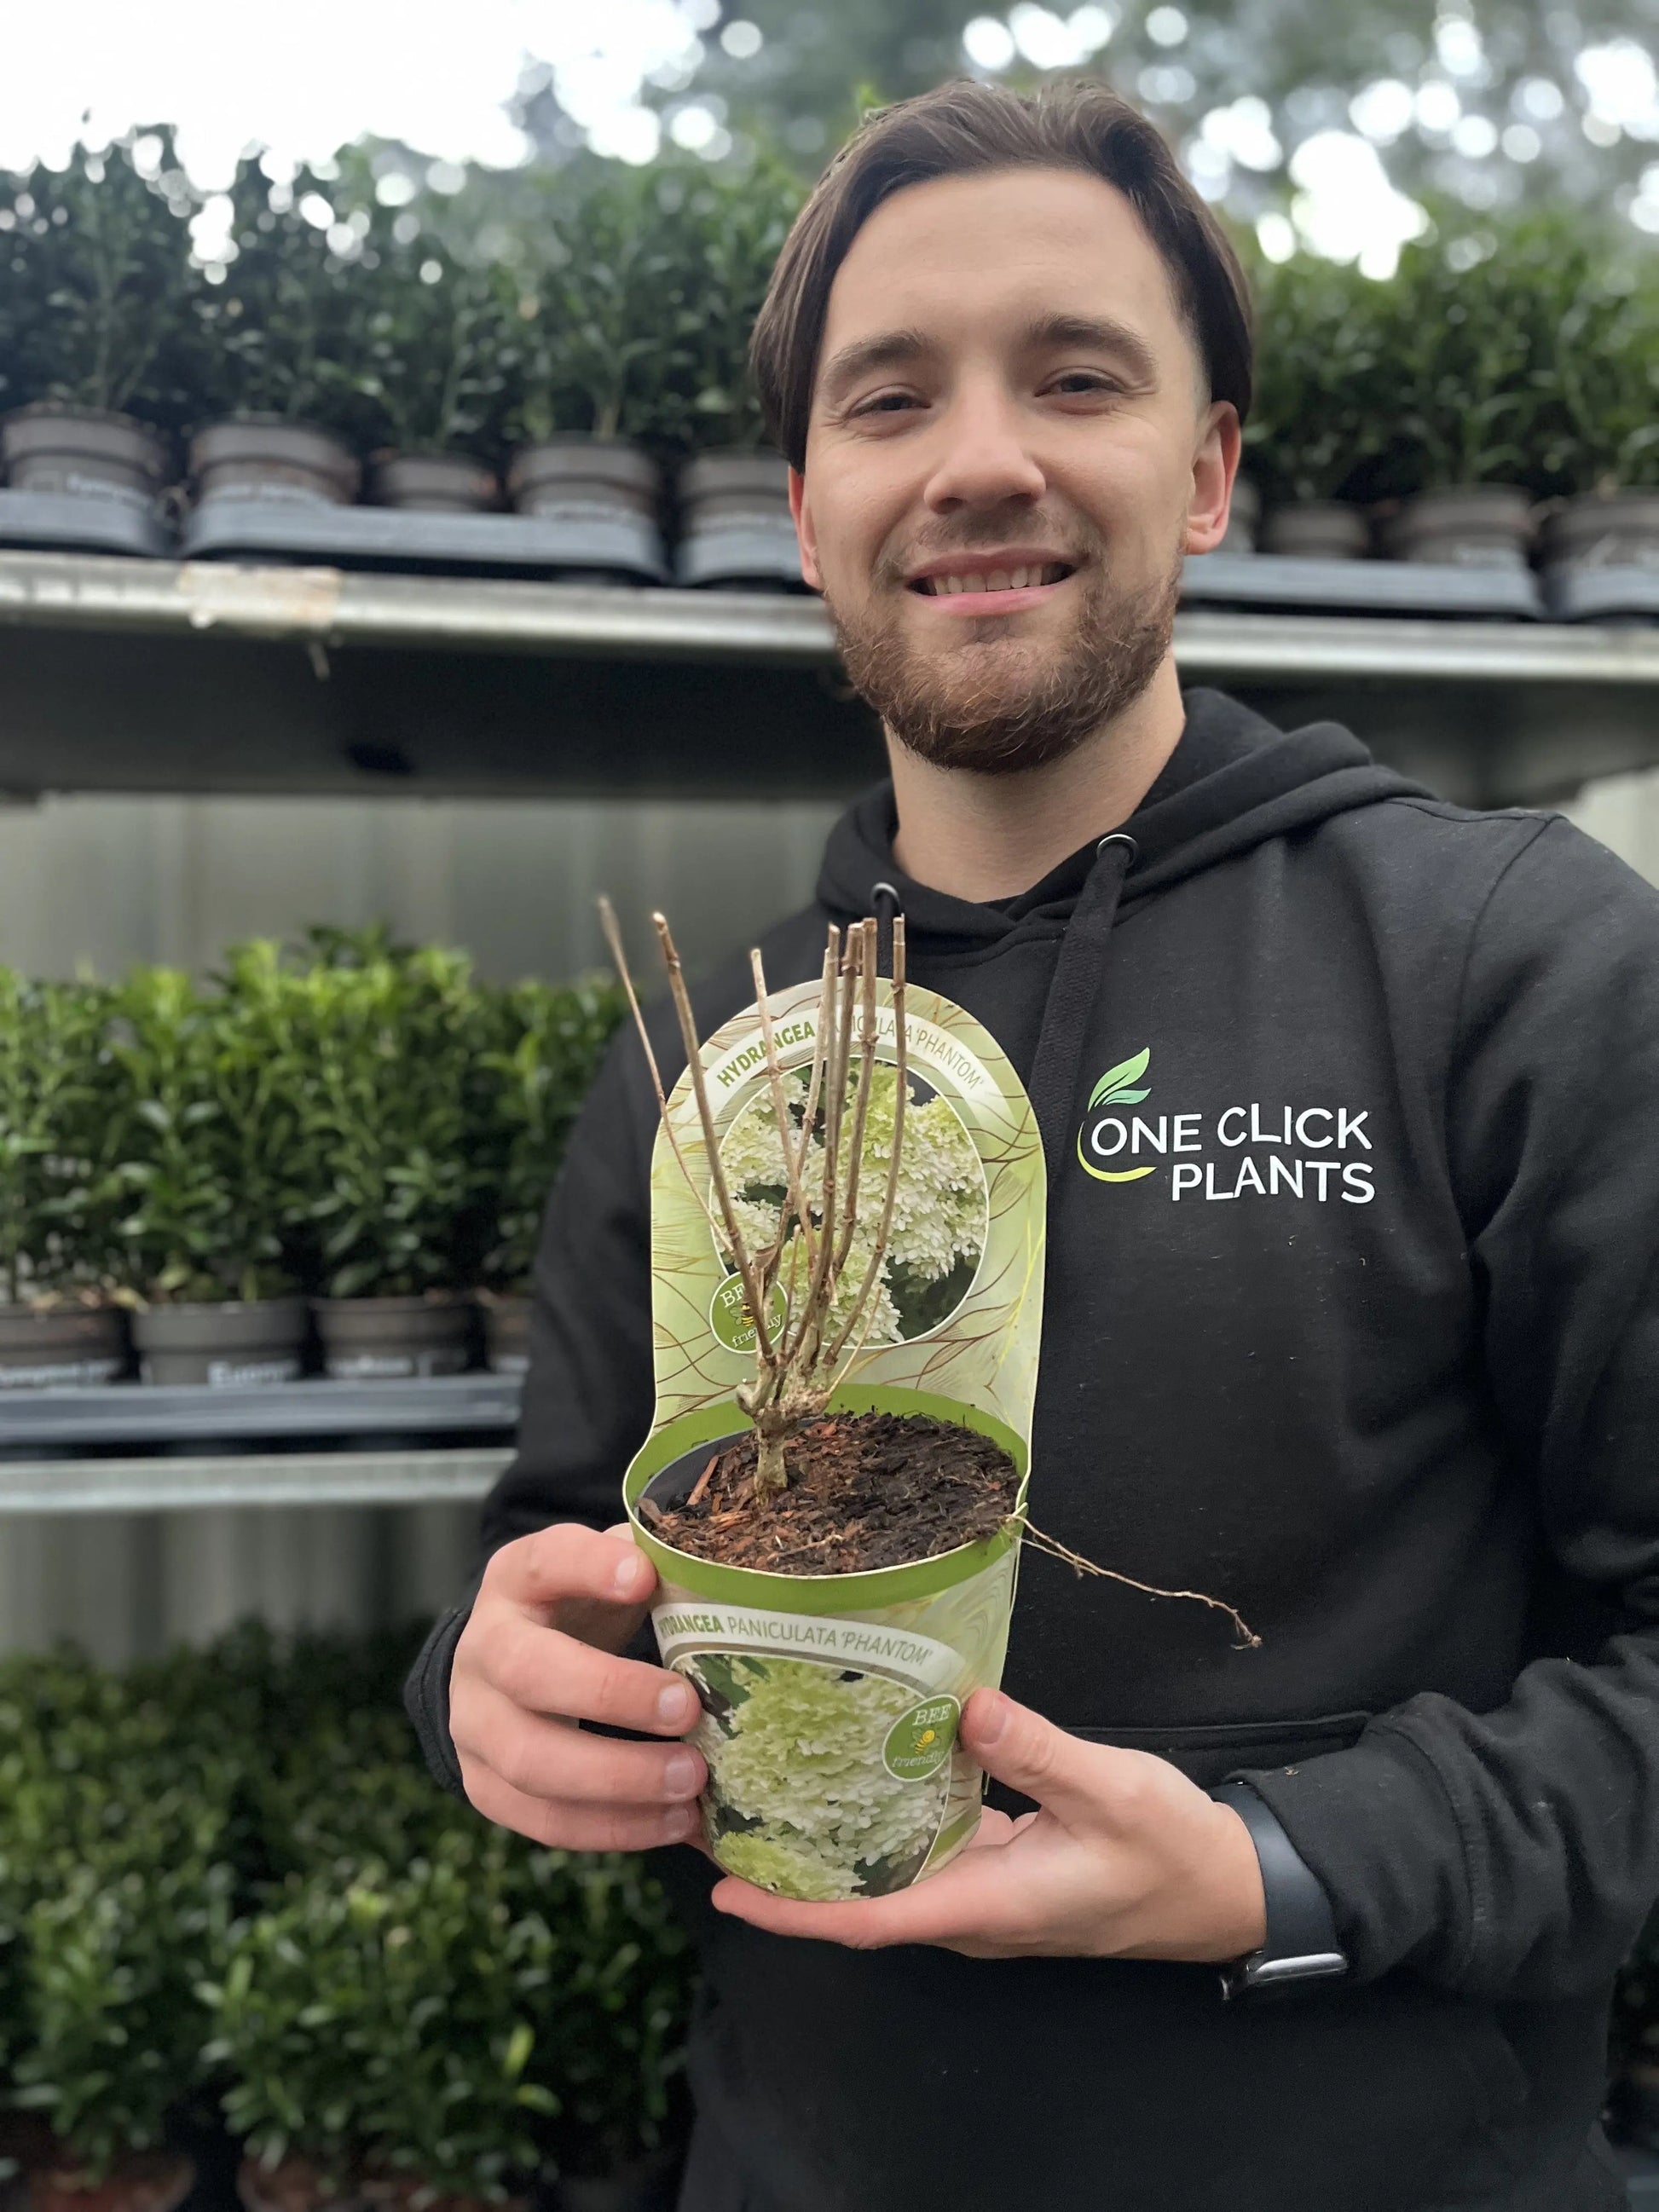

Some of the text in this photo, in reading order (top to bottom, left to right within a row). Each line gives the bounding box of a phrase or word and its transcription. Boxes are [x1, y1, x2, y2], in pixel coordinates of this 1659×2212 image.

[716, 1021, 816, 1089] HYDRANGEA
[1090, 1102, 1373, 1156] ONE CLICK
[1171, 1155, 1376, 1204] PLANTS
[727, 1616, 837, 1647] PANICULATA
[911, 1703, 952, 1726] BEE
